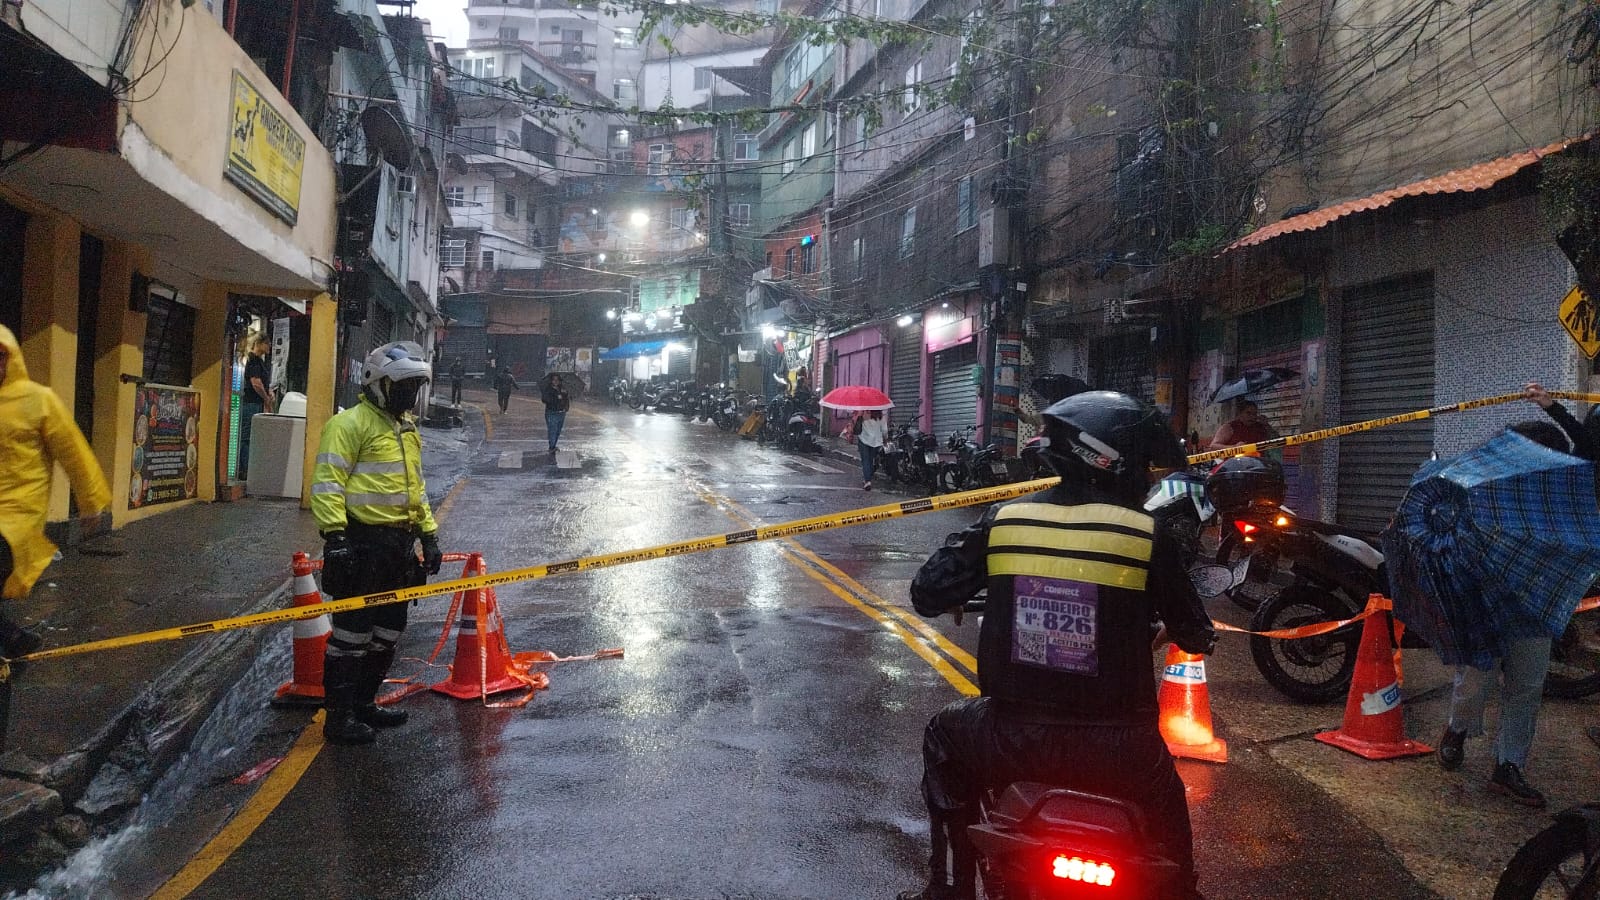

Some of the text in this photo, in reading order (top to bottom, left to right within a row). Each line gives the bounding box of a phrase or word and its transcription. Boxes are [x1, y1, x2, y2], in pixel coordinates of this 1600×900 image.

[1020, 597, 1091, 618] BOIADEIRO
[1043, 612, 1092, 636] 826
[1184, 665, 1202, 679] RIO
